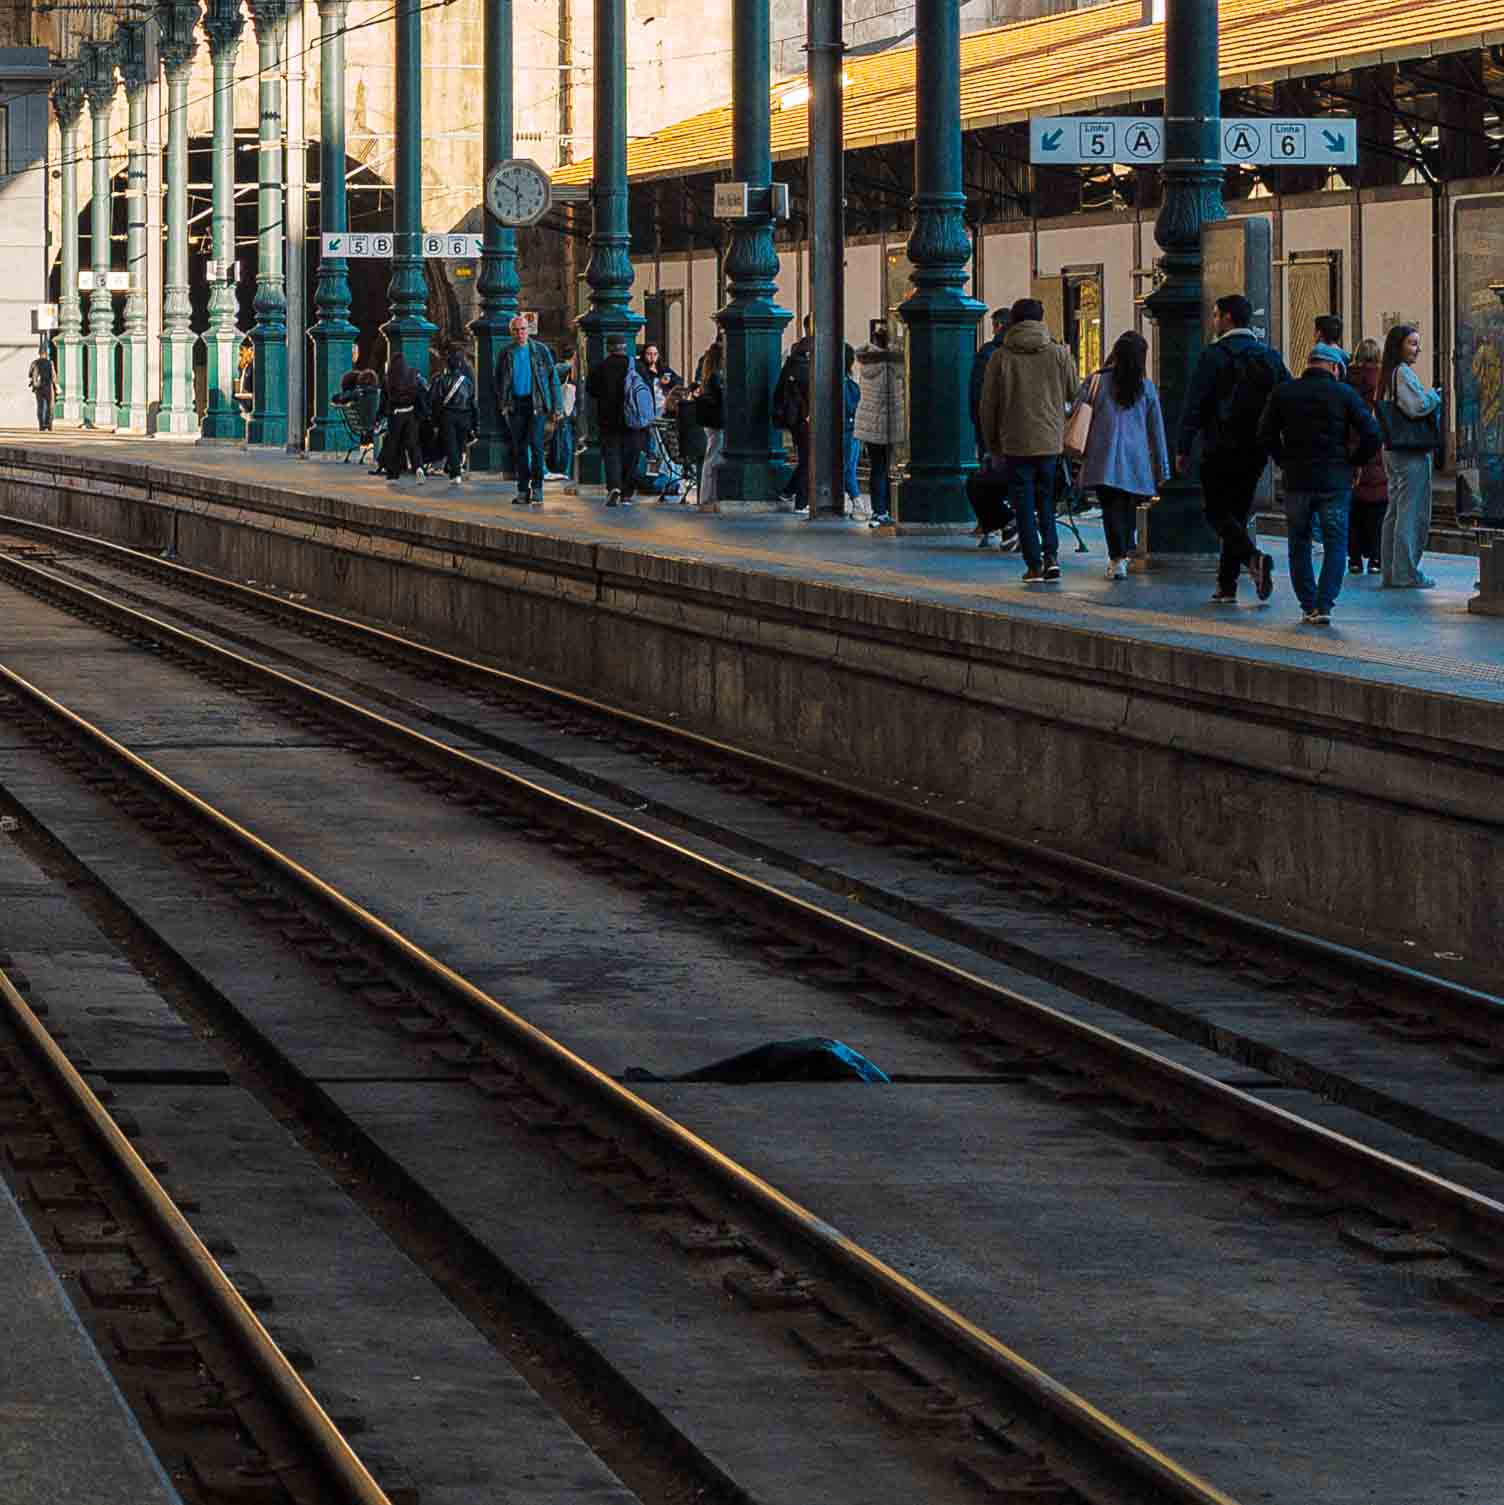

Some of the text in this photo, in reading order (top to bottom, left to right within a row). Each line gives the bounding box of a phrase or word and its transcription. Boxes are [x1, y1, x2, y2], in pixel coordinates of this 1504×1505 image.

[1091, 134, 1105, 155] 5
[1132, 130, 1153, 152] A
[1232, 131, 1253, 153] A
[1281, 135, 1296, 156] 6
[354, 241, 363, 254] 5
[378, 239, 388, 251] B
[428, 239, 439, 252] B
[453, 242, 462, 254] 6
